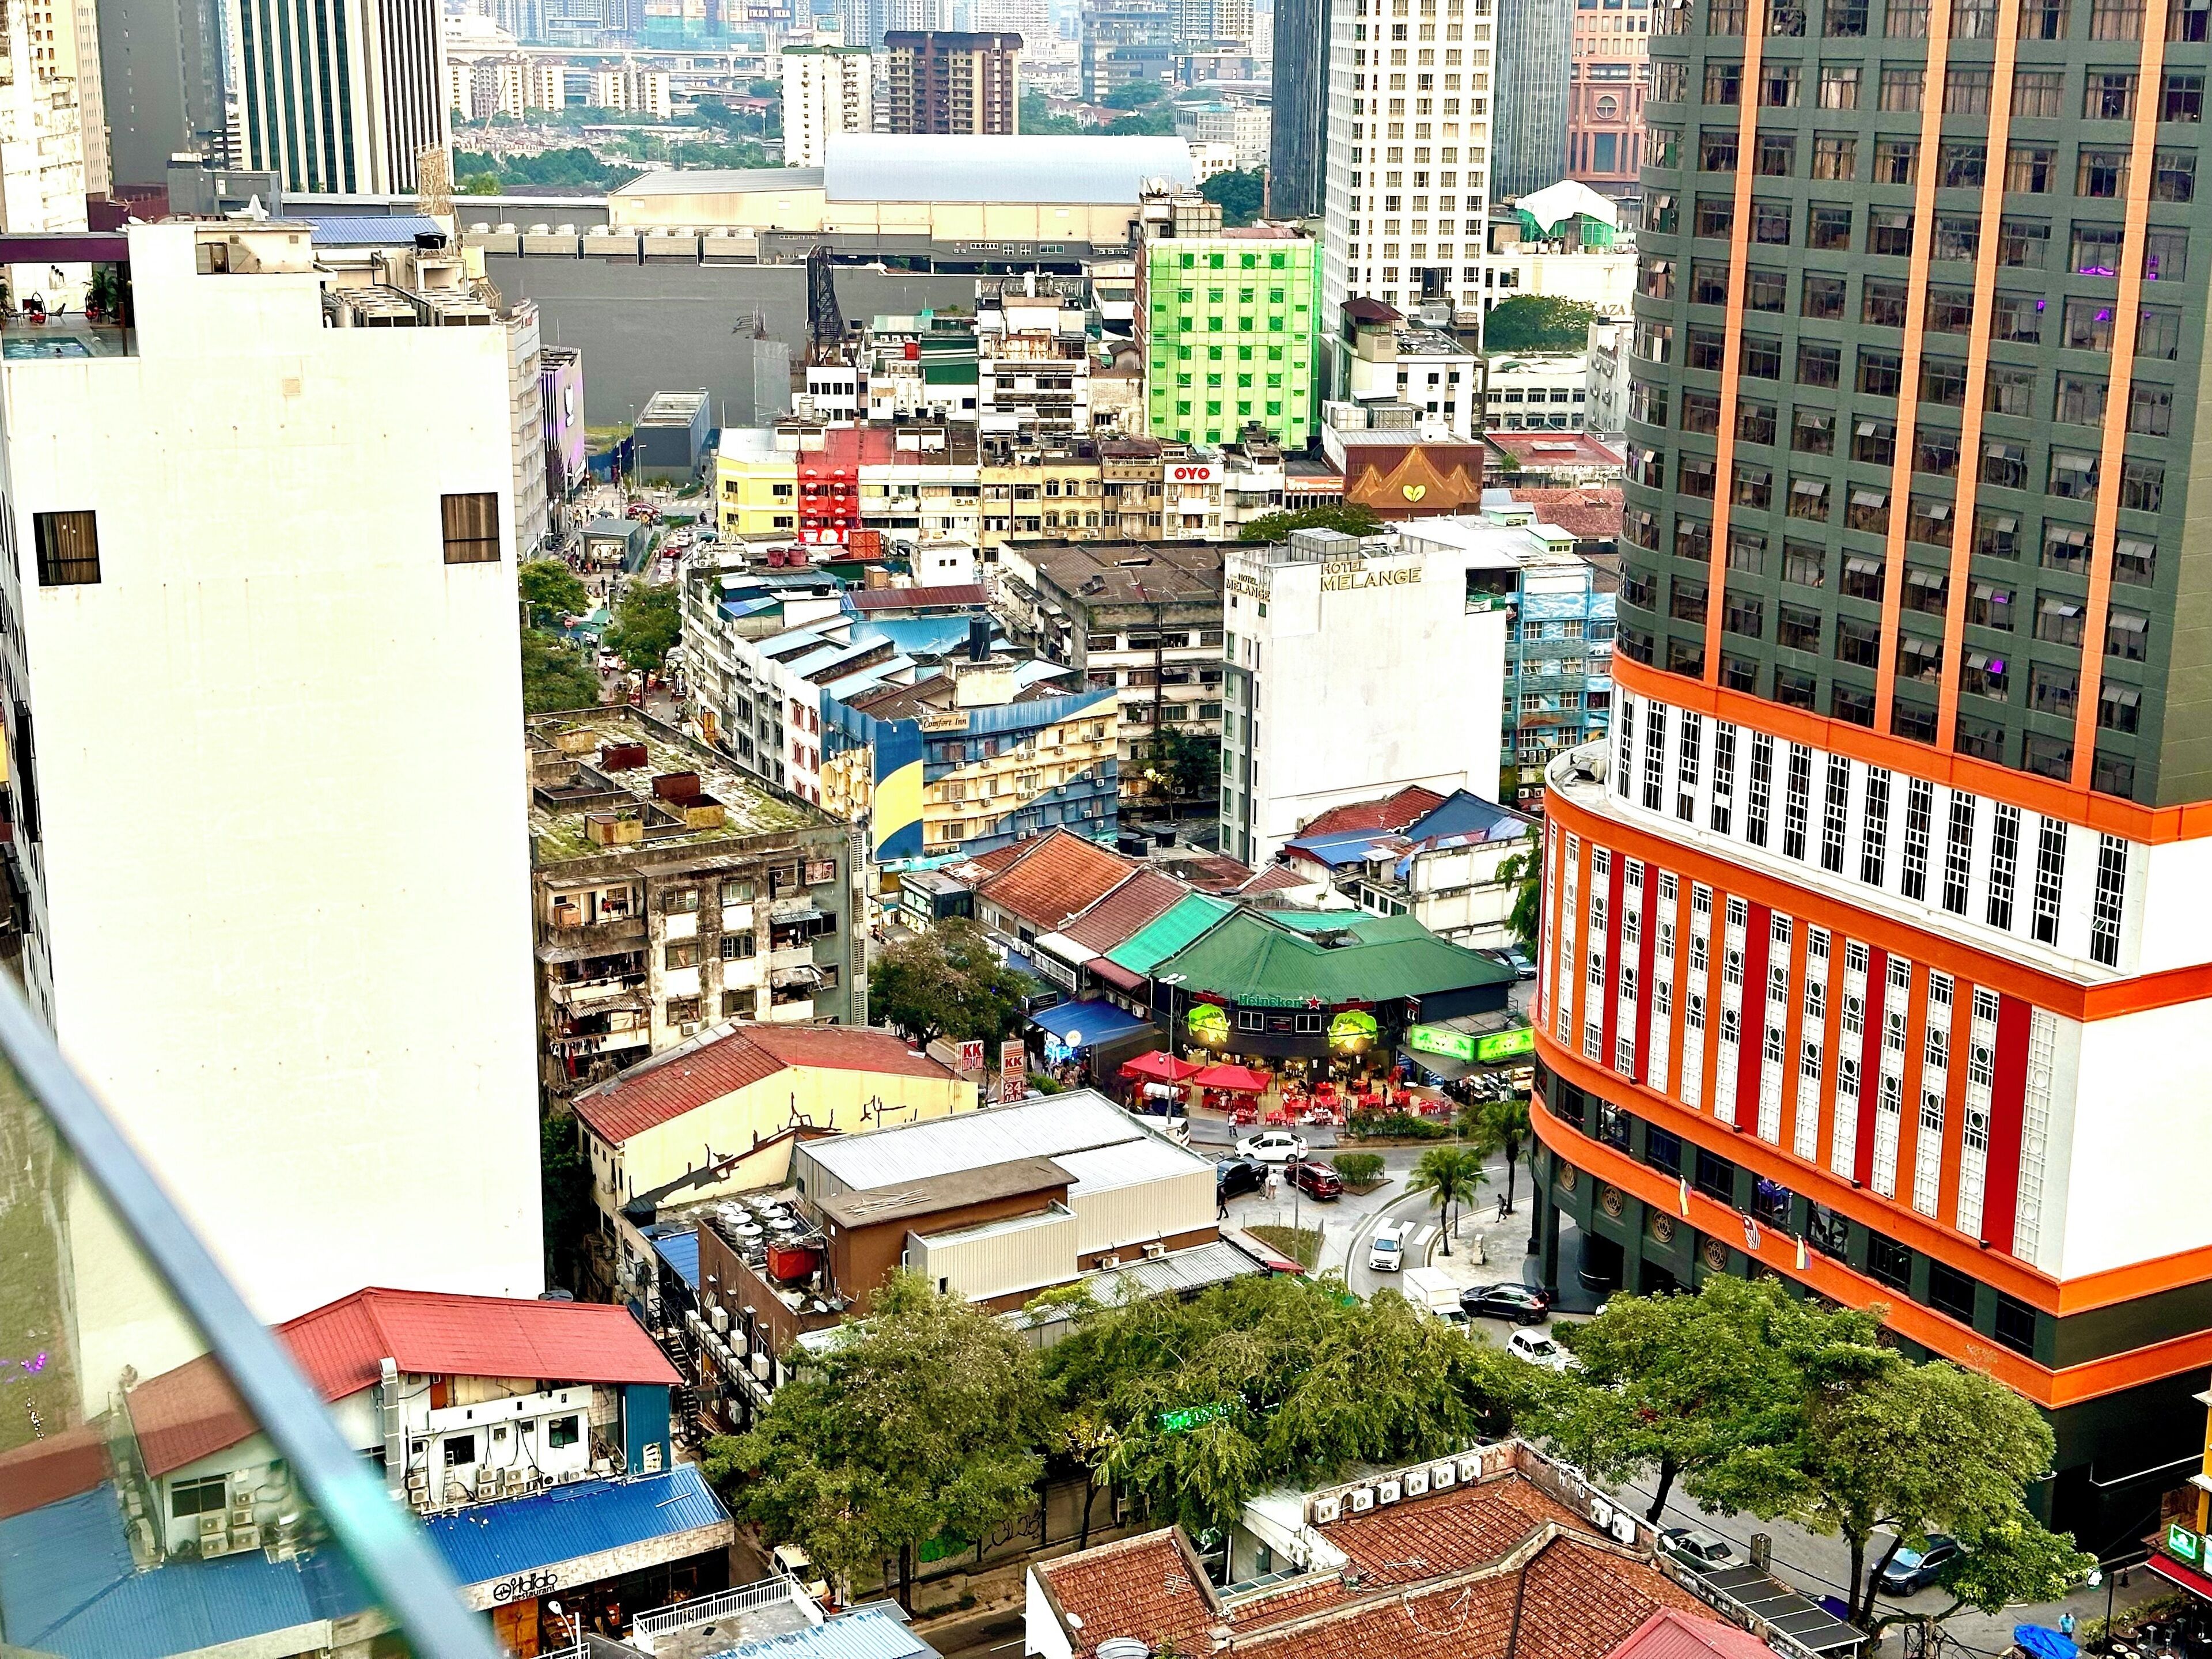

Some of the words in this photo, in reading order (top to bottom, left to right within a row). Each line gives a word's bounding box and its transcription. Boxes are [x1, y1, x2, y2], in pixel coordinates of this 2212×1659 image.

[1599, 304, 1626, 315] AZA
[1175, 467, 1210, 480] OYO
[1321, 560, 1368, 575] HOTEL
[1238, 573, 1258, 586] HOTEL
[1320, 567, 1422, 592] MELANGE
[1226, 578, 1271, 603] MELANGE
[923, 718, 952, 729] Comfort
[1238, 993, 1304, 1009] Heineken
[964, 1042, 982, 1058] KK
[1005, 1056, 1022, 1068] KK
[1005, 1081, 1022, 1096] 24
[512, 1584, 556, 1602] Restaurant
